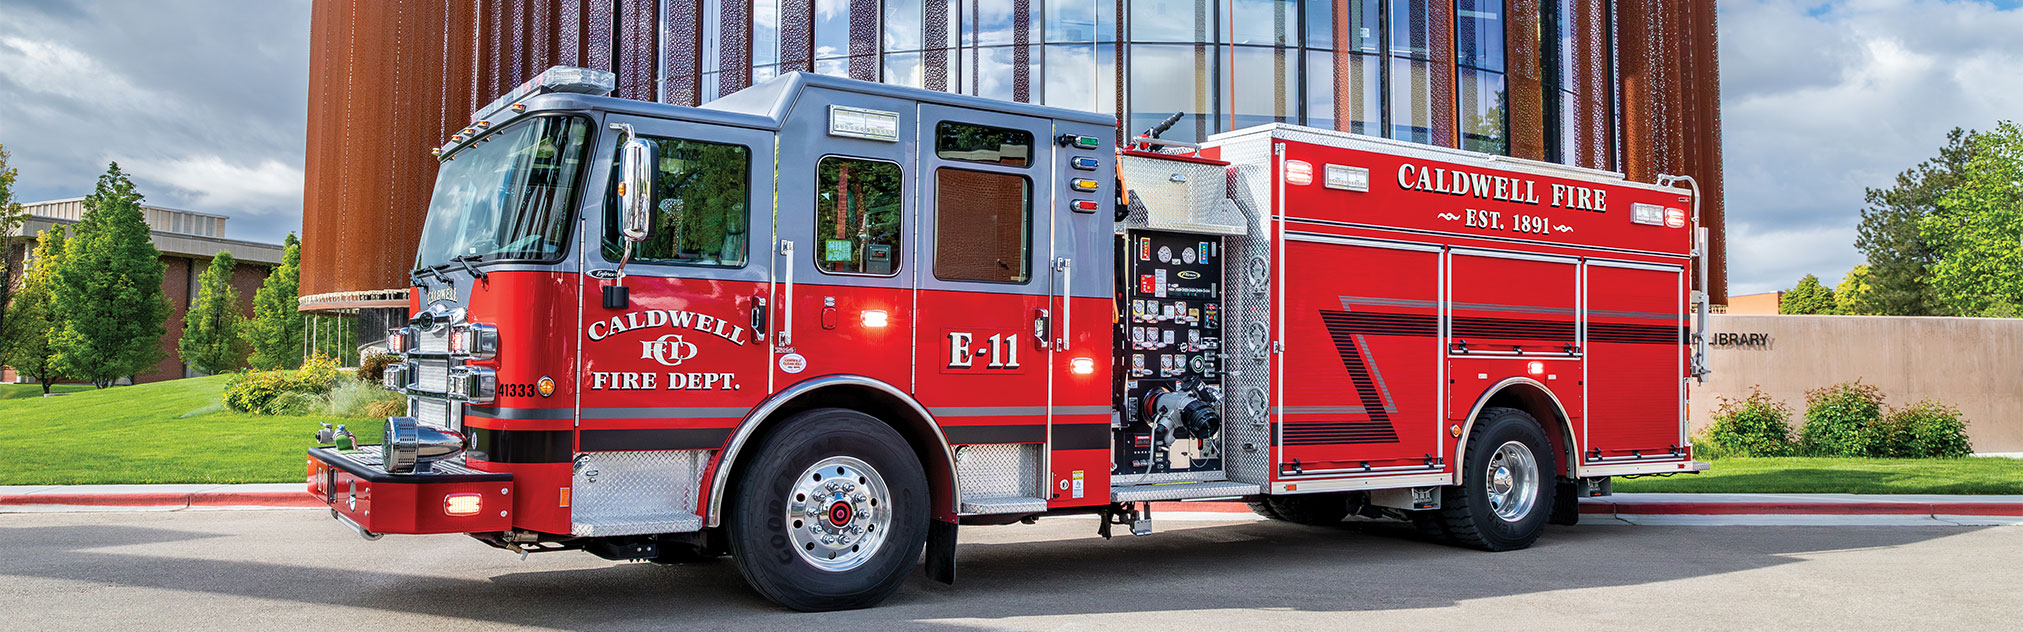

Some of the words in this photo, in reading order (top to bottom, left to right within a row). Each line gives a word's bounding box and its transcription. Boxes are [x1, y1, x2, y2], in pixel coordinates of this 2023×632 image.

[1397, 163, 1540, 205] CALDWELL
[1550, 183, 1608, 212] FIRE
[1465, 208, 1505, 230] EST.
[1512, 213, 1550, 235] 1891
[427, 287, 458, 306] CALDWELL
[587, 309, 745, 346] CALDWELL
[1708, 332, 1769, 346] IBRARY
[946, 331, 1021, 370] E-11
[498, 383, 536, 398] 41333
[590, 371, 658, 391] FIRE
[667, 371, 741, 391] DEPT.
